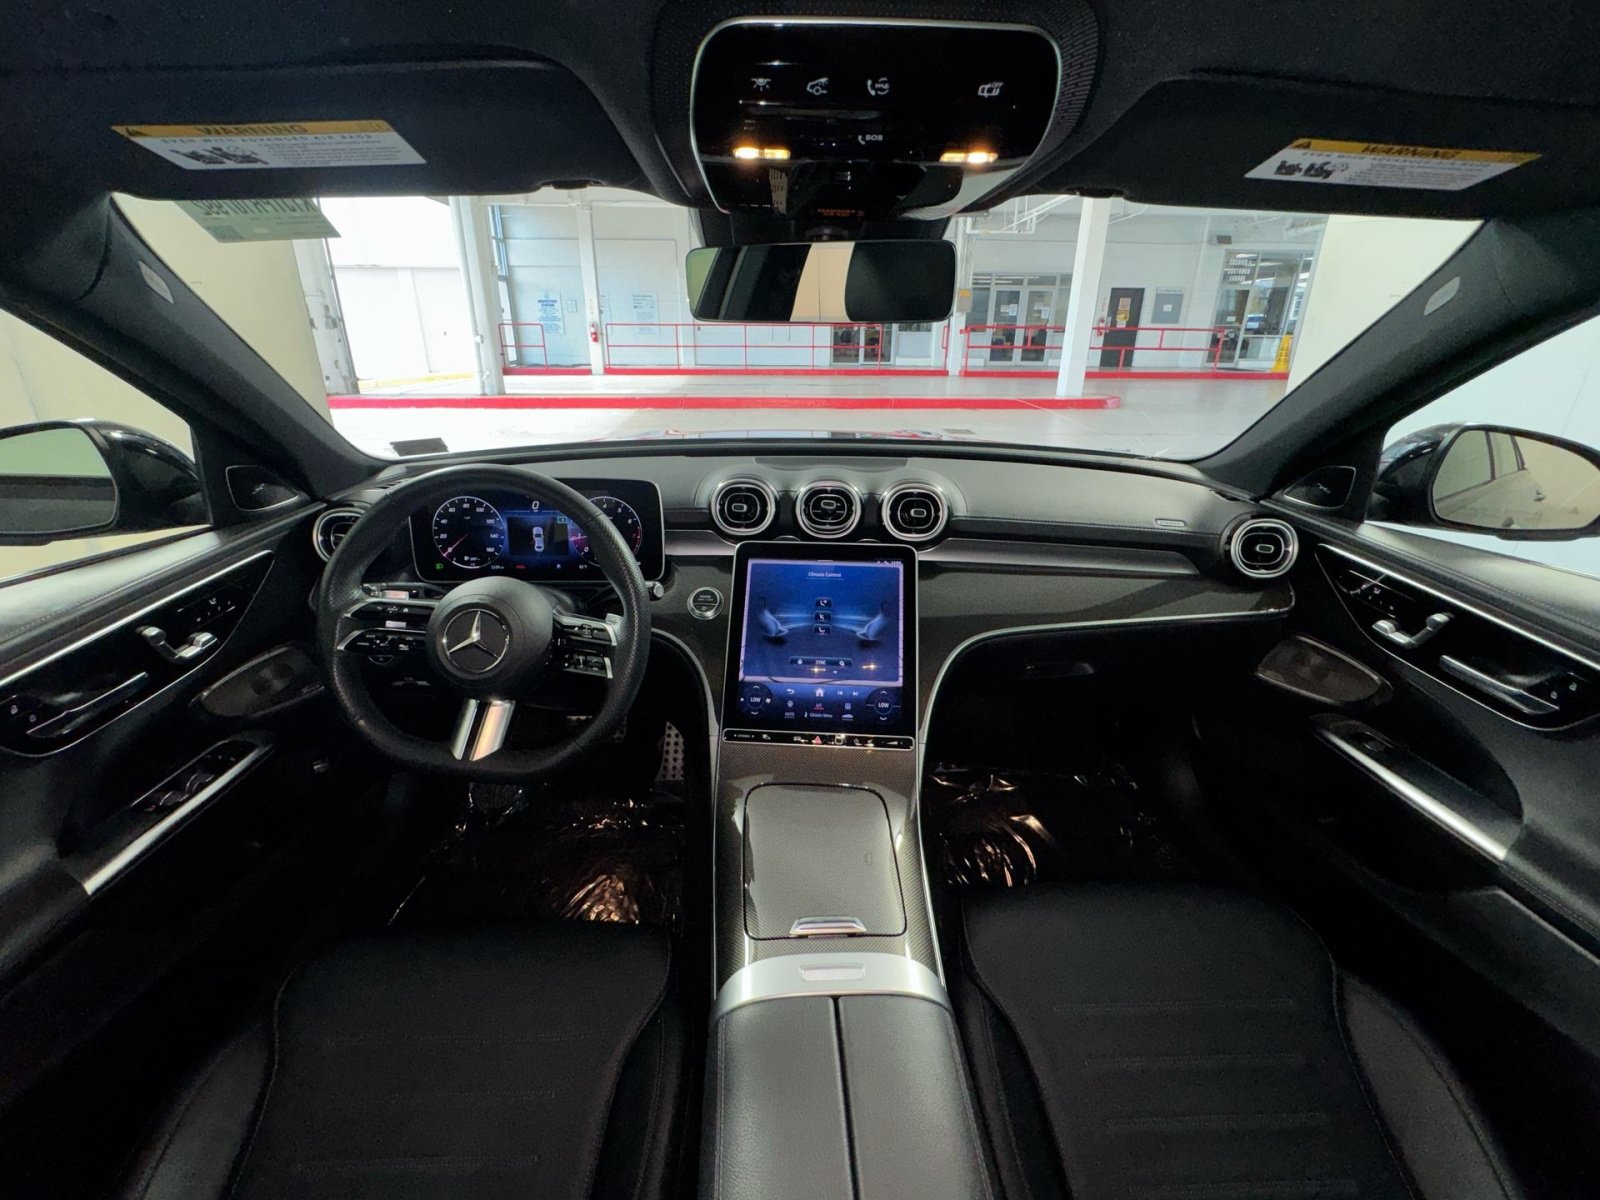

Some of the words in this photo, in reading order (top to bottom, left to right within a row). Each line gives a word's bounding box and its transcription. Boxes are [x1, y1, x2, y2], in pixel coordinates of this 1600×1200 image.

[195, 124, 308, 136] WARNING
[1362, 145, 1461, 159] WARNING
[531, 501, 540, 510] 0
